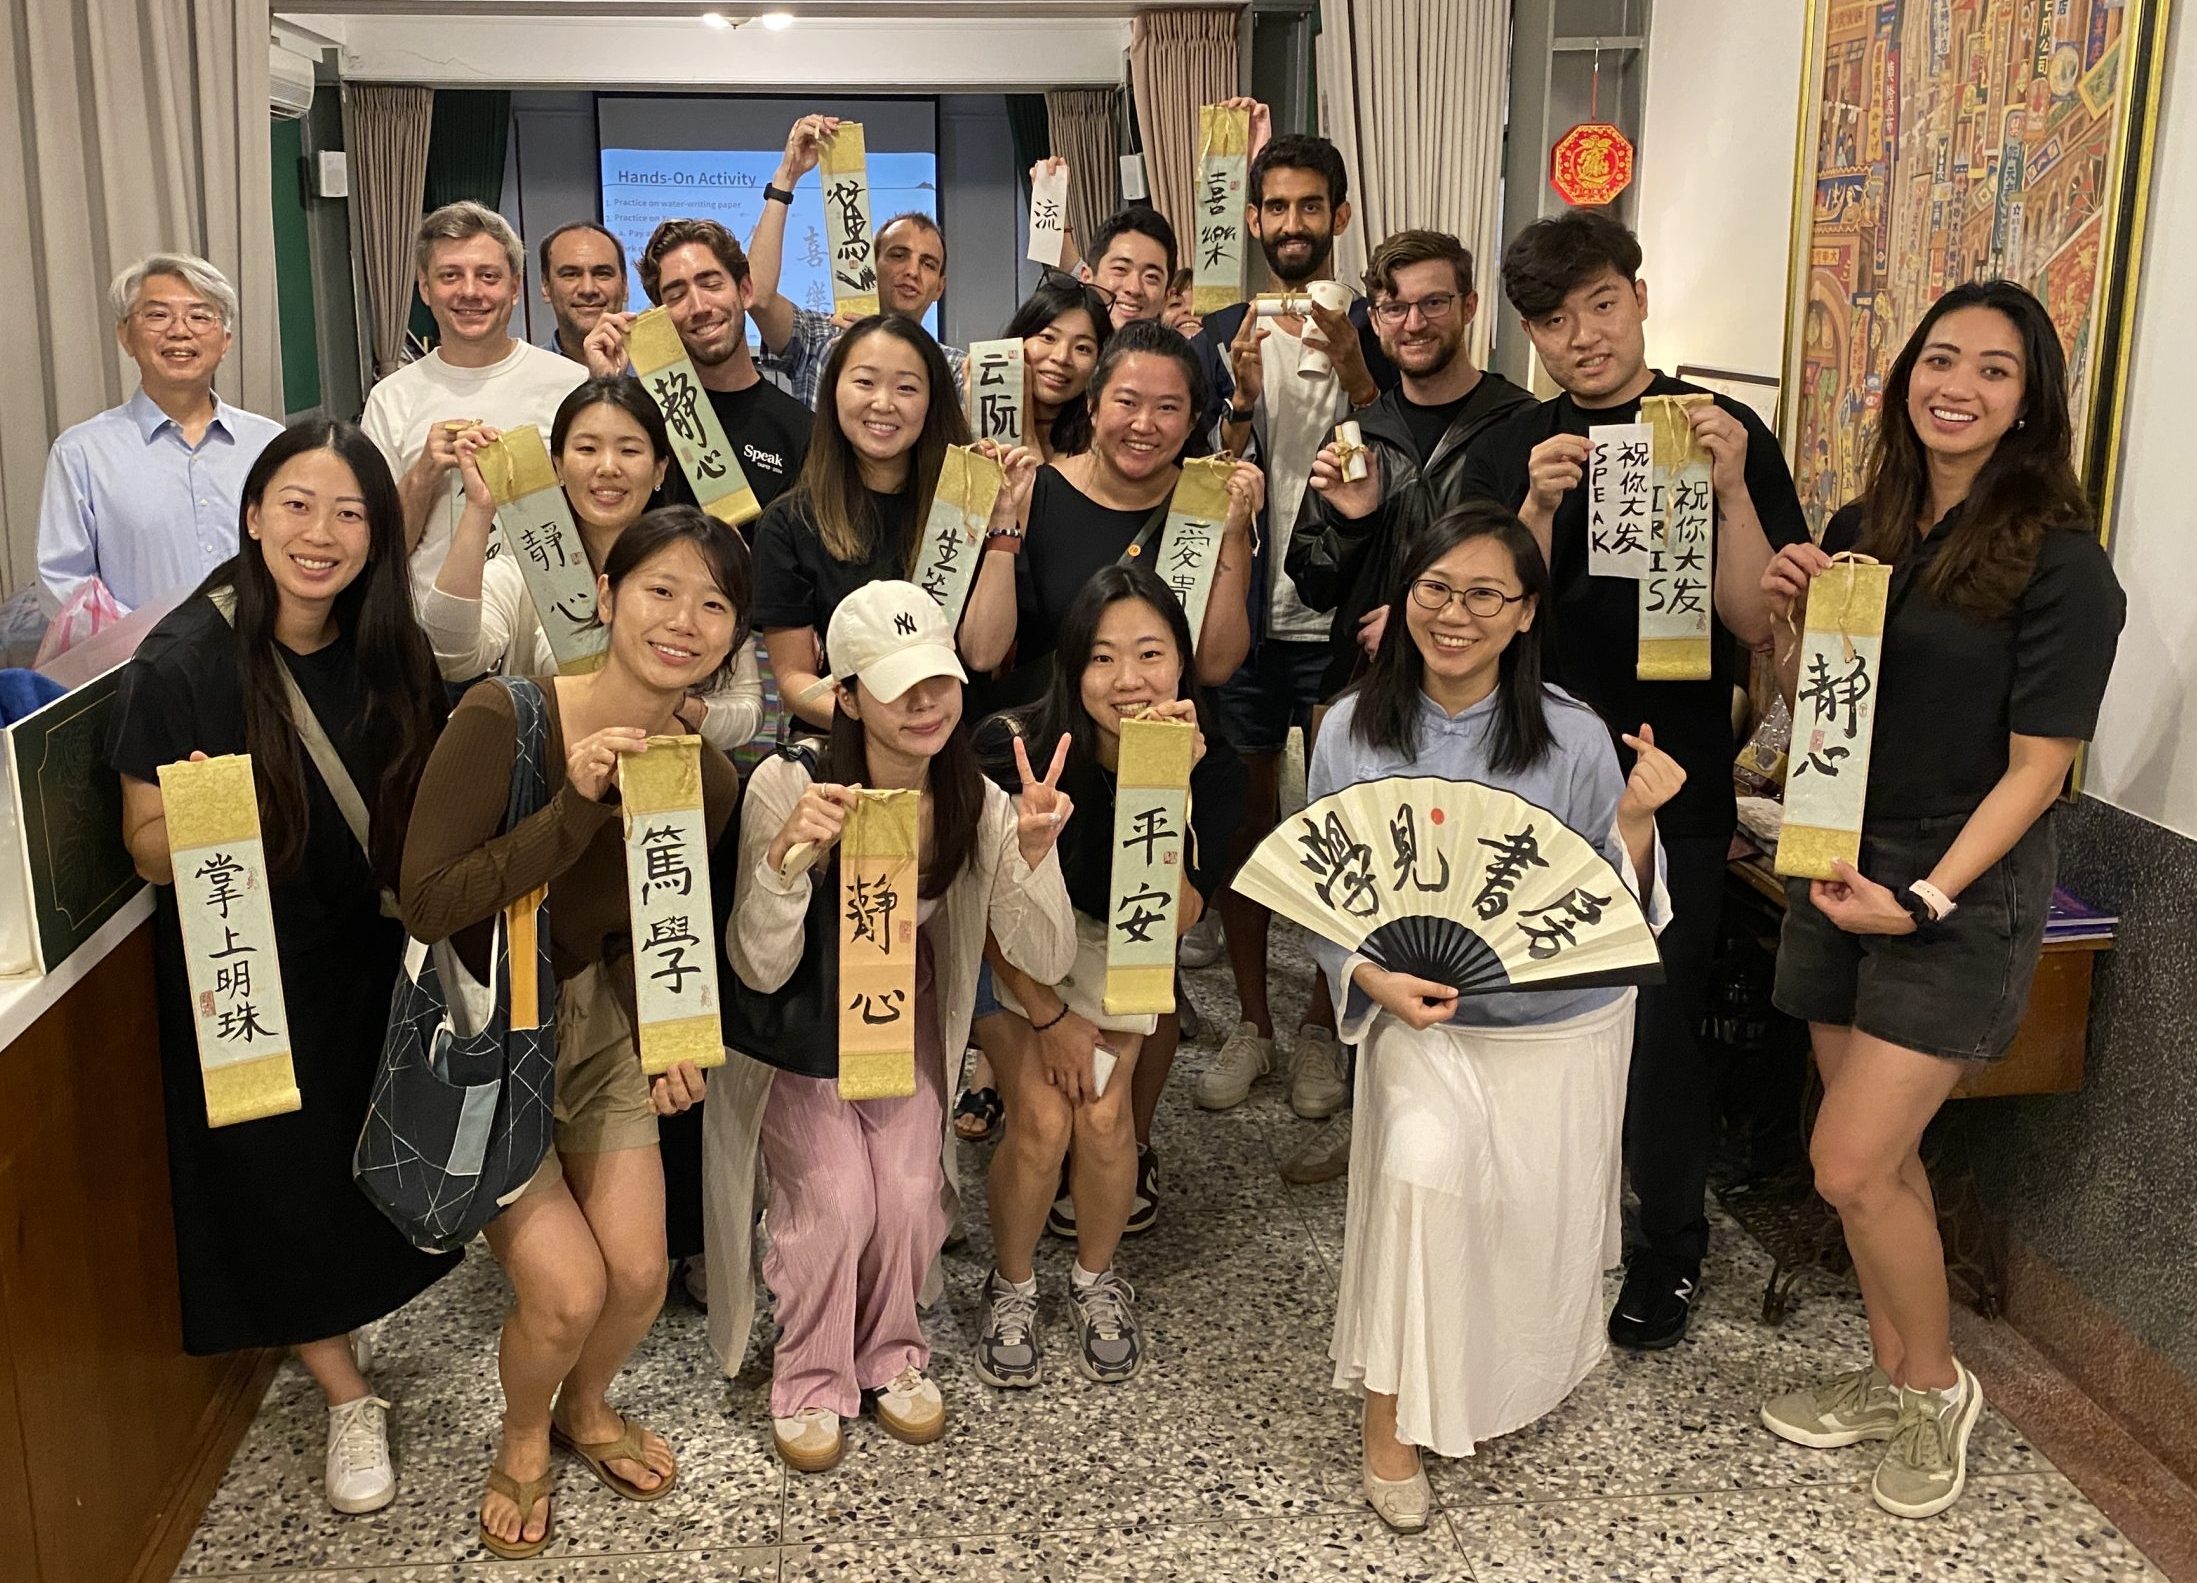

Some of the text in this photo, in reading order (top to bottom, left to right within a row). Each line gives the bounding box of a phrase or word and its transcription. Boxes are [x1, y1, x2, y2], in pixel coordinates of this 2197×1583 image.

[618, 170, 757, 188] Hands-On Activity
[614, 198, 647, 207] Practice
[648, 200, 660, 208] on
[660, 200, 716, 210] water-writing
[614, 214, 647, 222] Practice
[1033, 198, 1062, 232] 流
[629, 230, 645, 238] Pay
[743, 444, 783, 467] Speak
[1592, 443, 1611, 554] SPEAK
[1611, 440, 1650, 555] 祝你大发
[1667, 479, 1709, 615] 祝你大发
[894, 611, 917, 636] NY
[1115, 806, 1179, 944] 平安
[194, 853, 279, 1043] 掌上明珠
